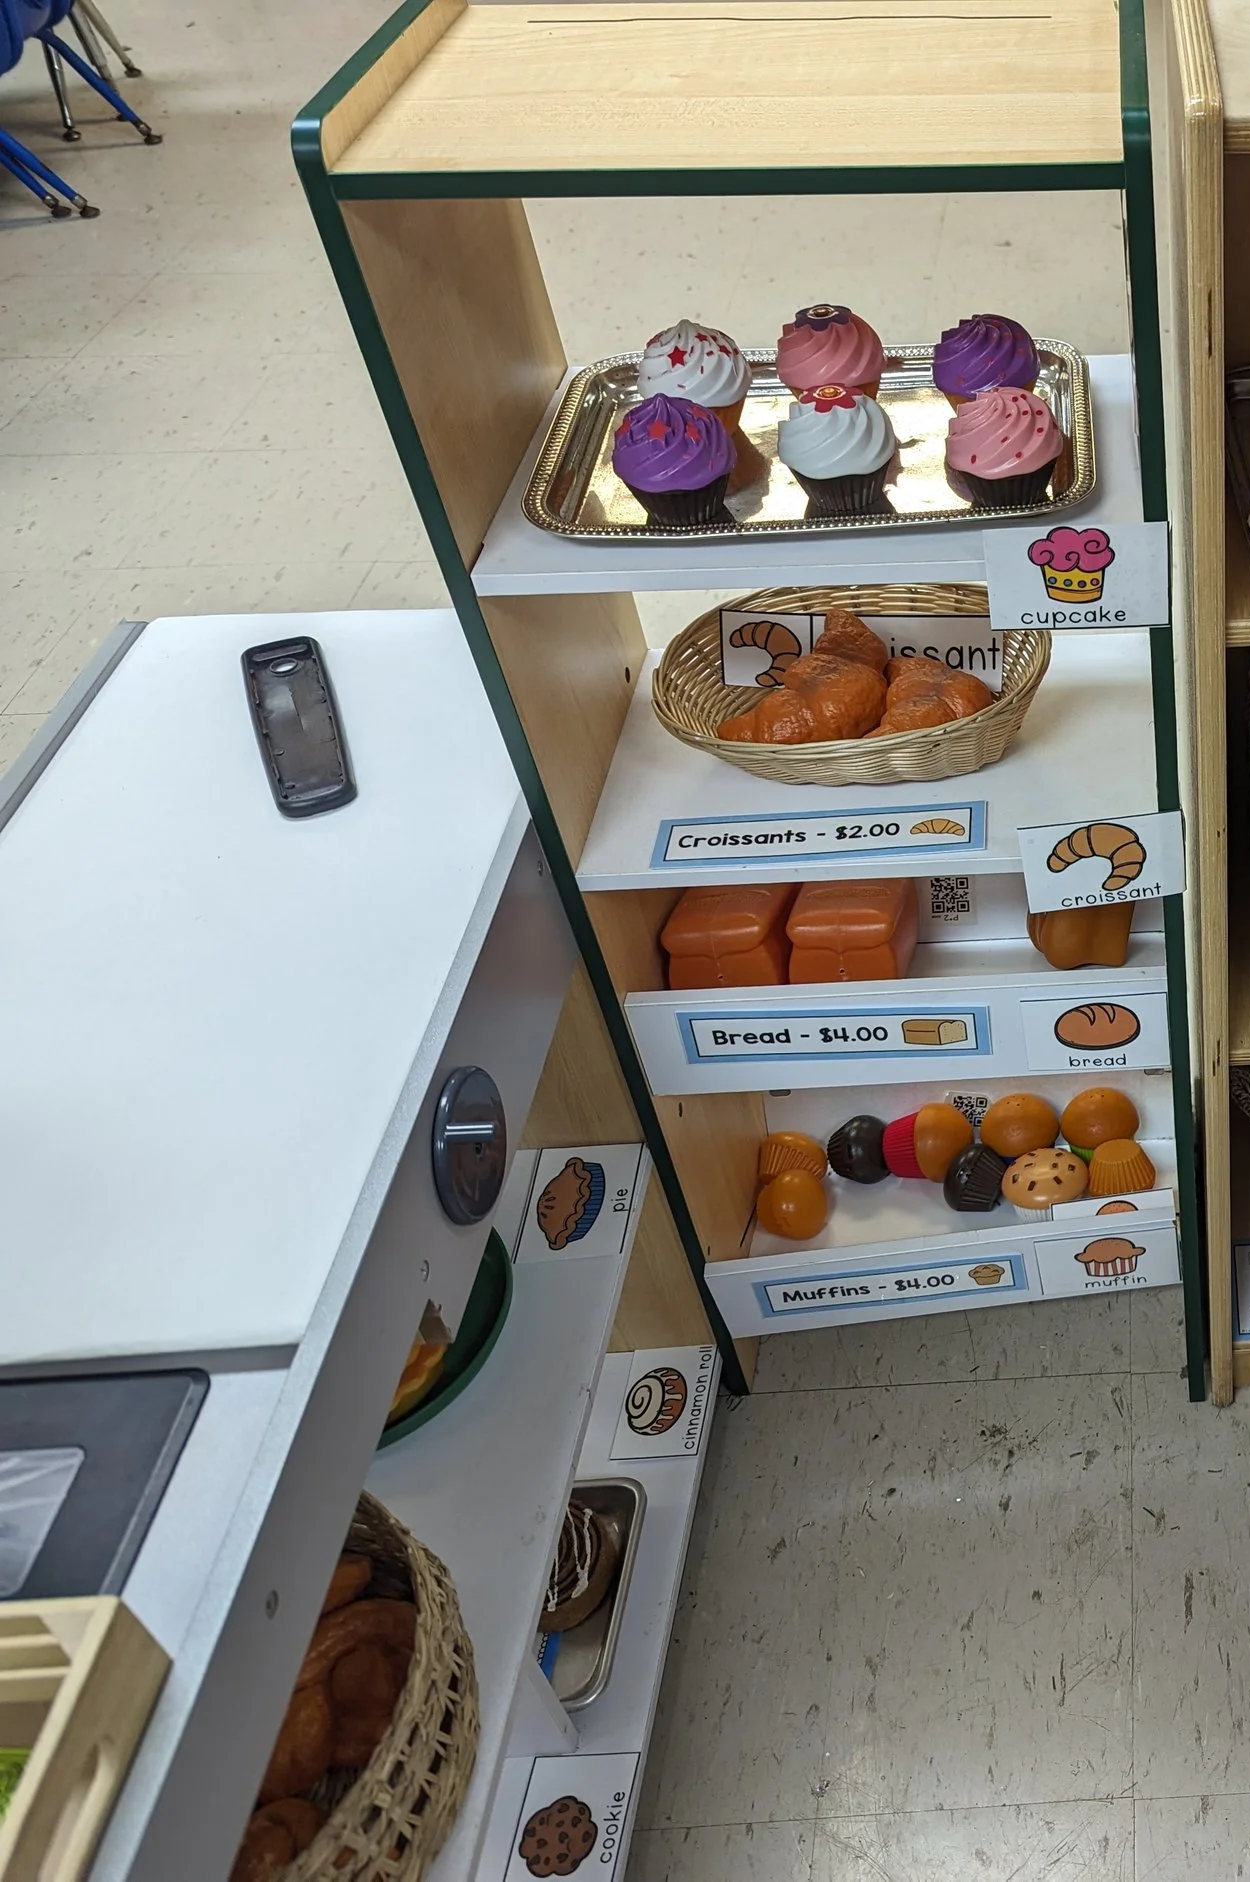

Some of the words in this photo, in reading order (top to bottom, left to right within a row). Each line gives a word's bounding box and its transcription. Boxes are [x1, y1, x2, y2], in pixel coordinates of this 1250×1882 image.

[1020, 606, 1127, 628] cupcake
[678, 829, 807, 849] Croissants
[835, 822, 900, 840] $2.00
[1061, 882, 1161, 907] croissant
[711, 1028, 791, 1046] Bread
[819, 1026, 889, 1043] $4.00
[1068, 1053, 1127, 1067] bread
[610, 1188, 629, 1213] pie
[782, 1284, 871, 1303] Muffins
[894, 1274, 955, 1292] $4.00
[1085, 1275, 1147, 1289] muffin
[682, 1374, 709, 1450] cinnamon
[699, 1345, 713, 1370] roll
[599, 1791, 626, 1864] cookie
